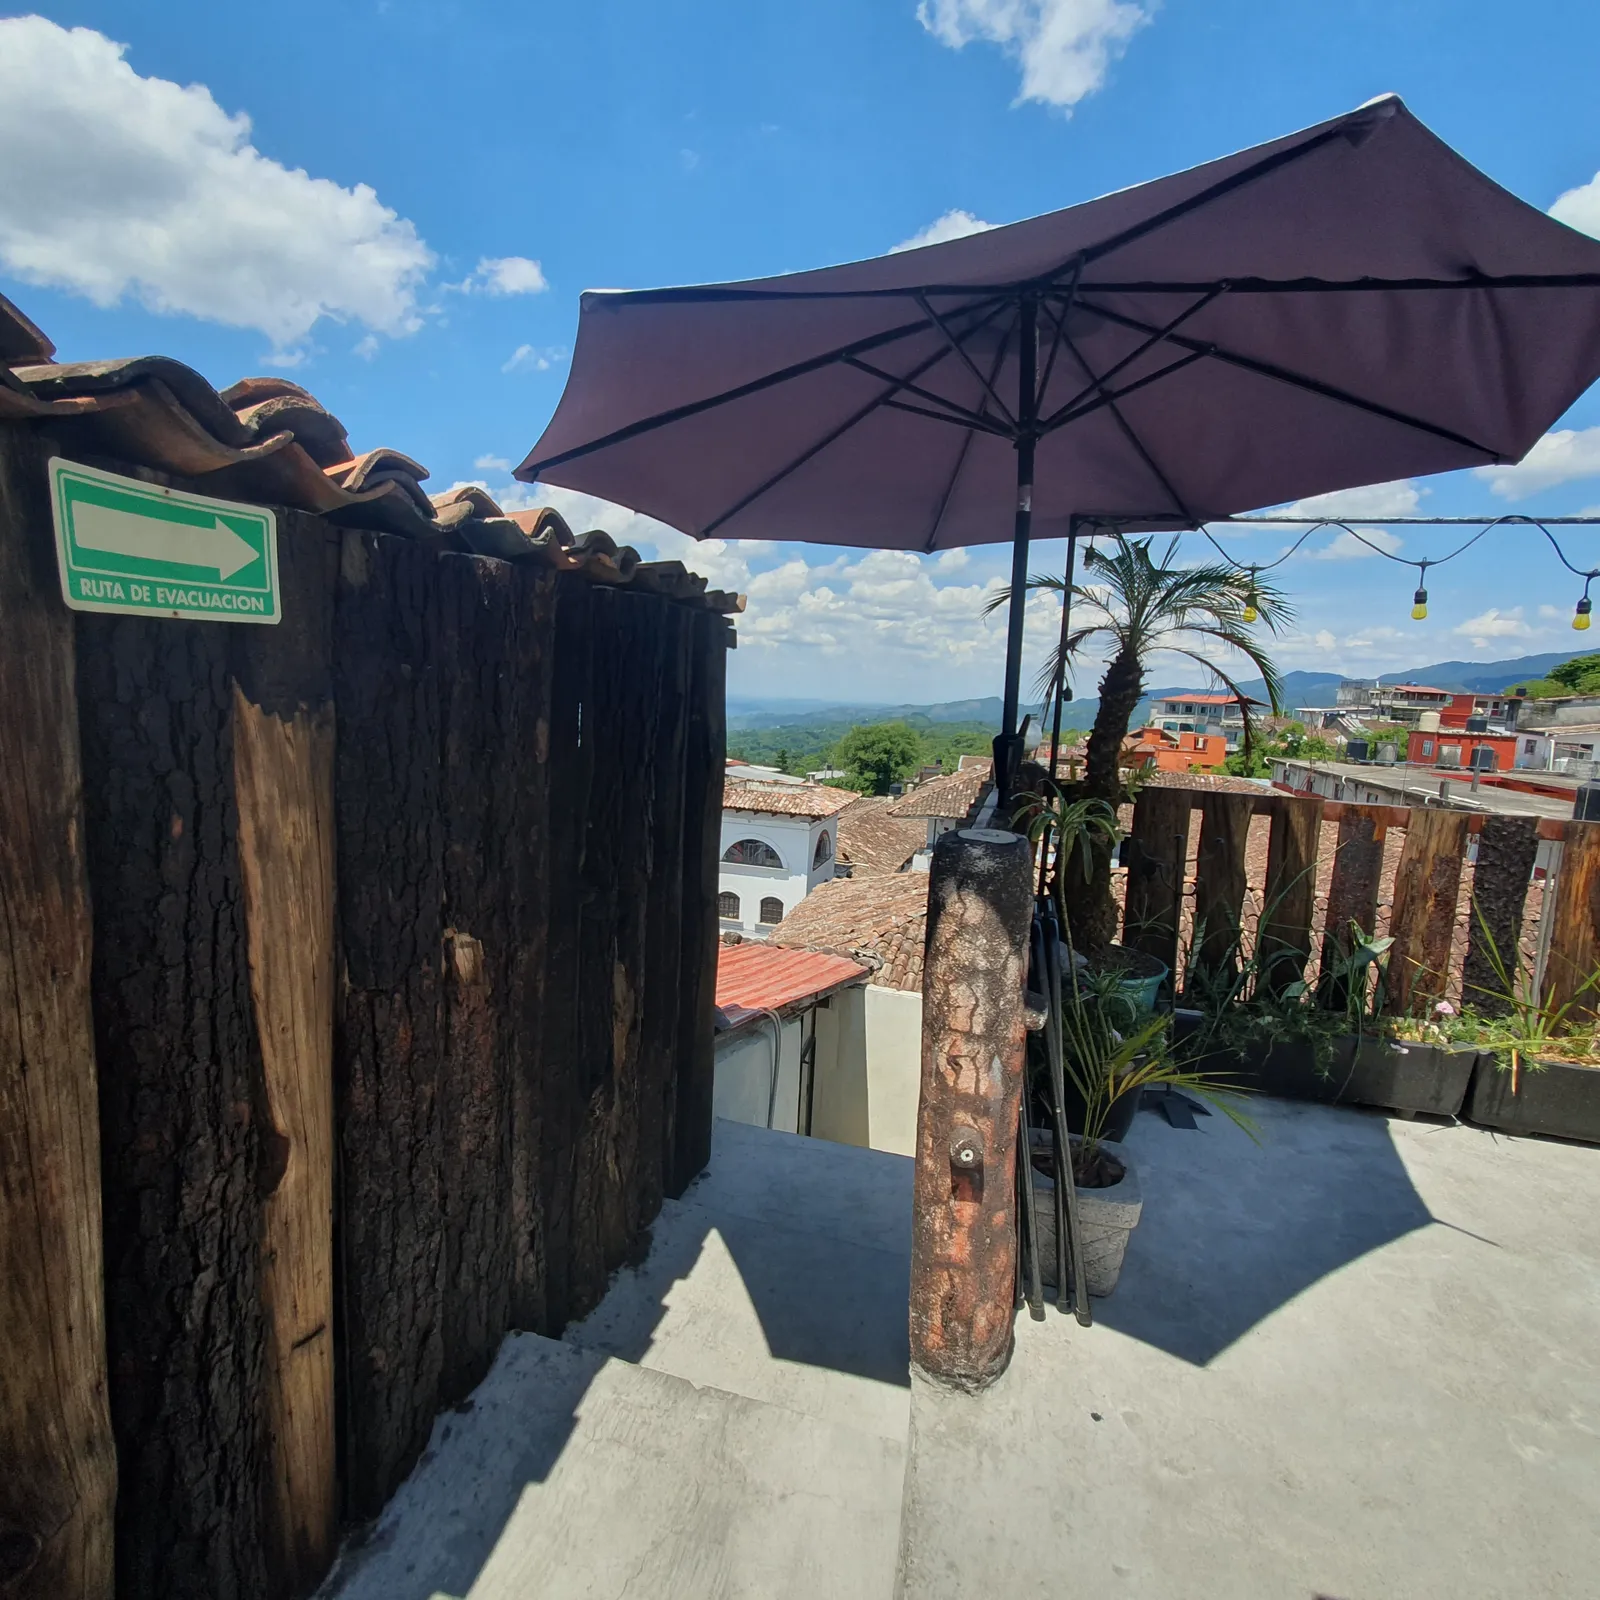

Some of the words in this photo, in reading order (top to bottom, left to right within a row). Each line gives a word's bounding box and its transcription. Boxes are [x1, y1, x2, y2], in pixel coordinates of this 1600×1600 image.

[80, 578, 125, 600] RUTA
[131, 584, 151, 602] DE
[156, 587, 265, 611] EVACUACION
